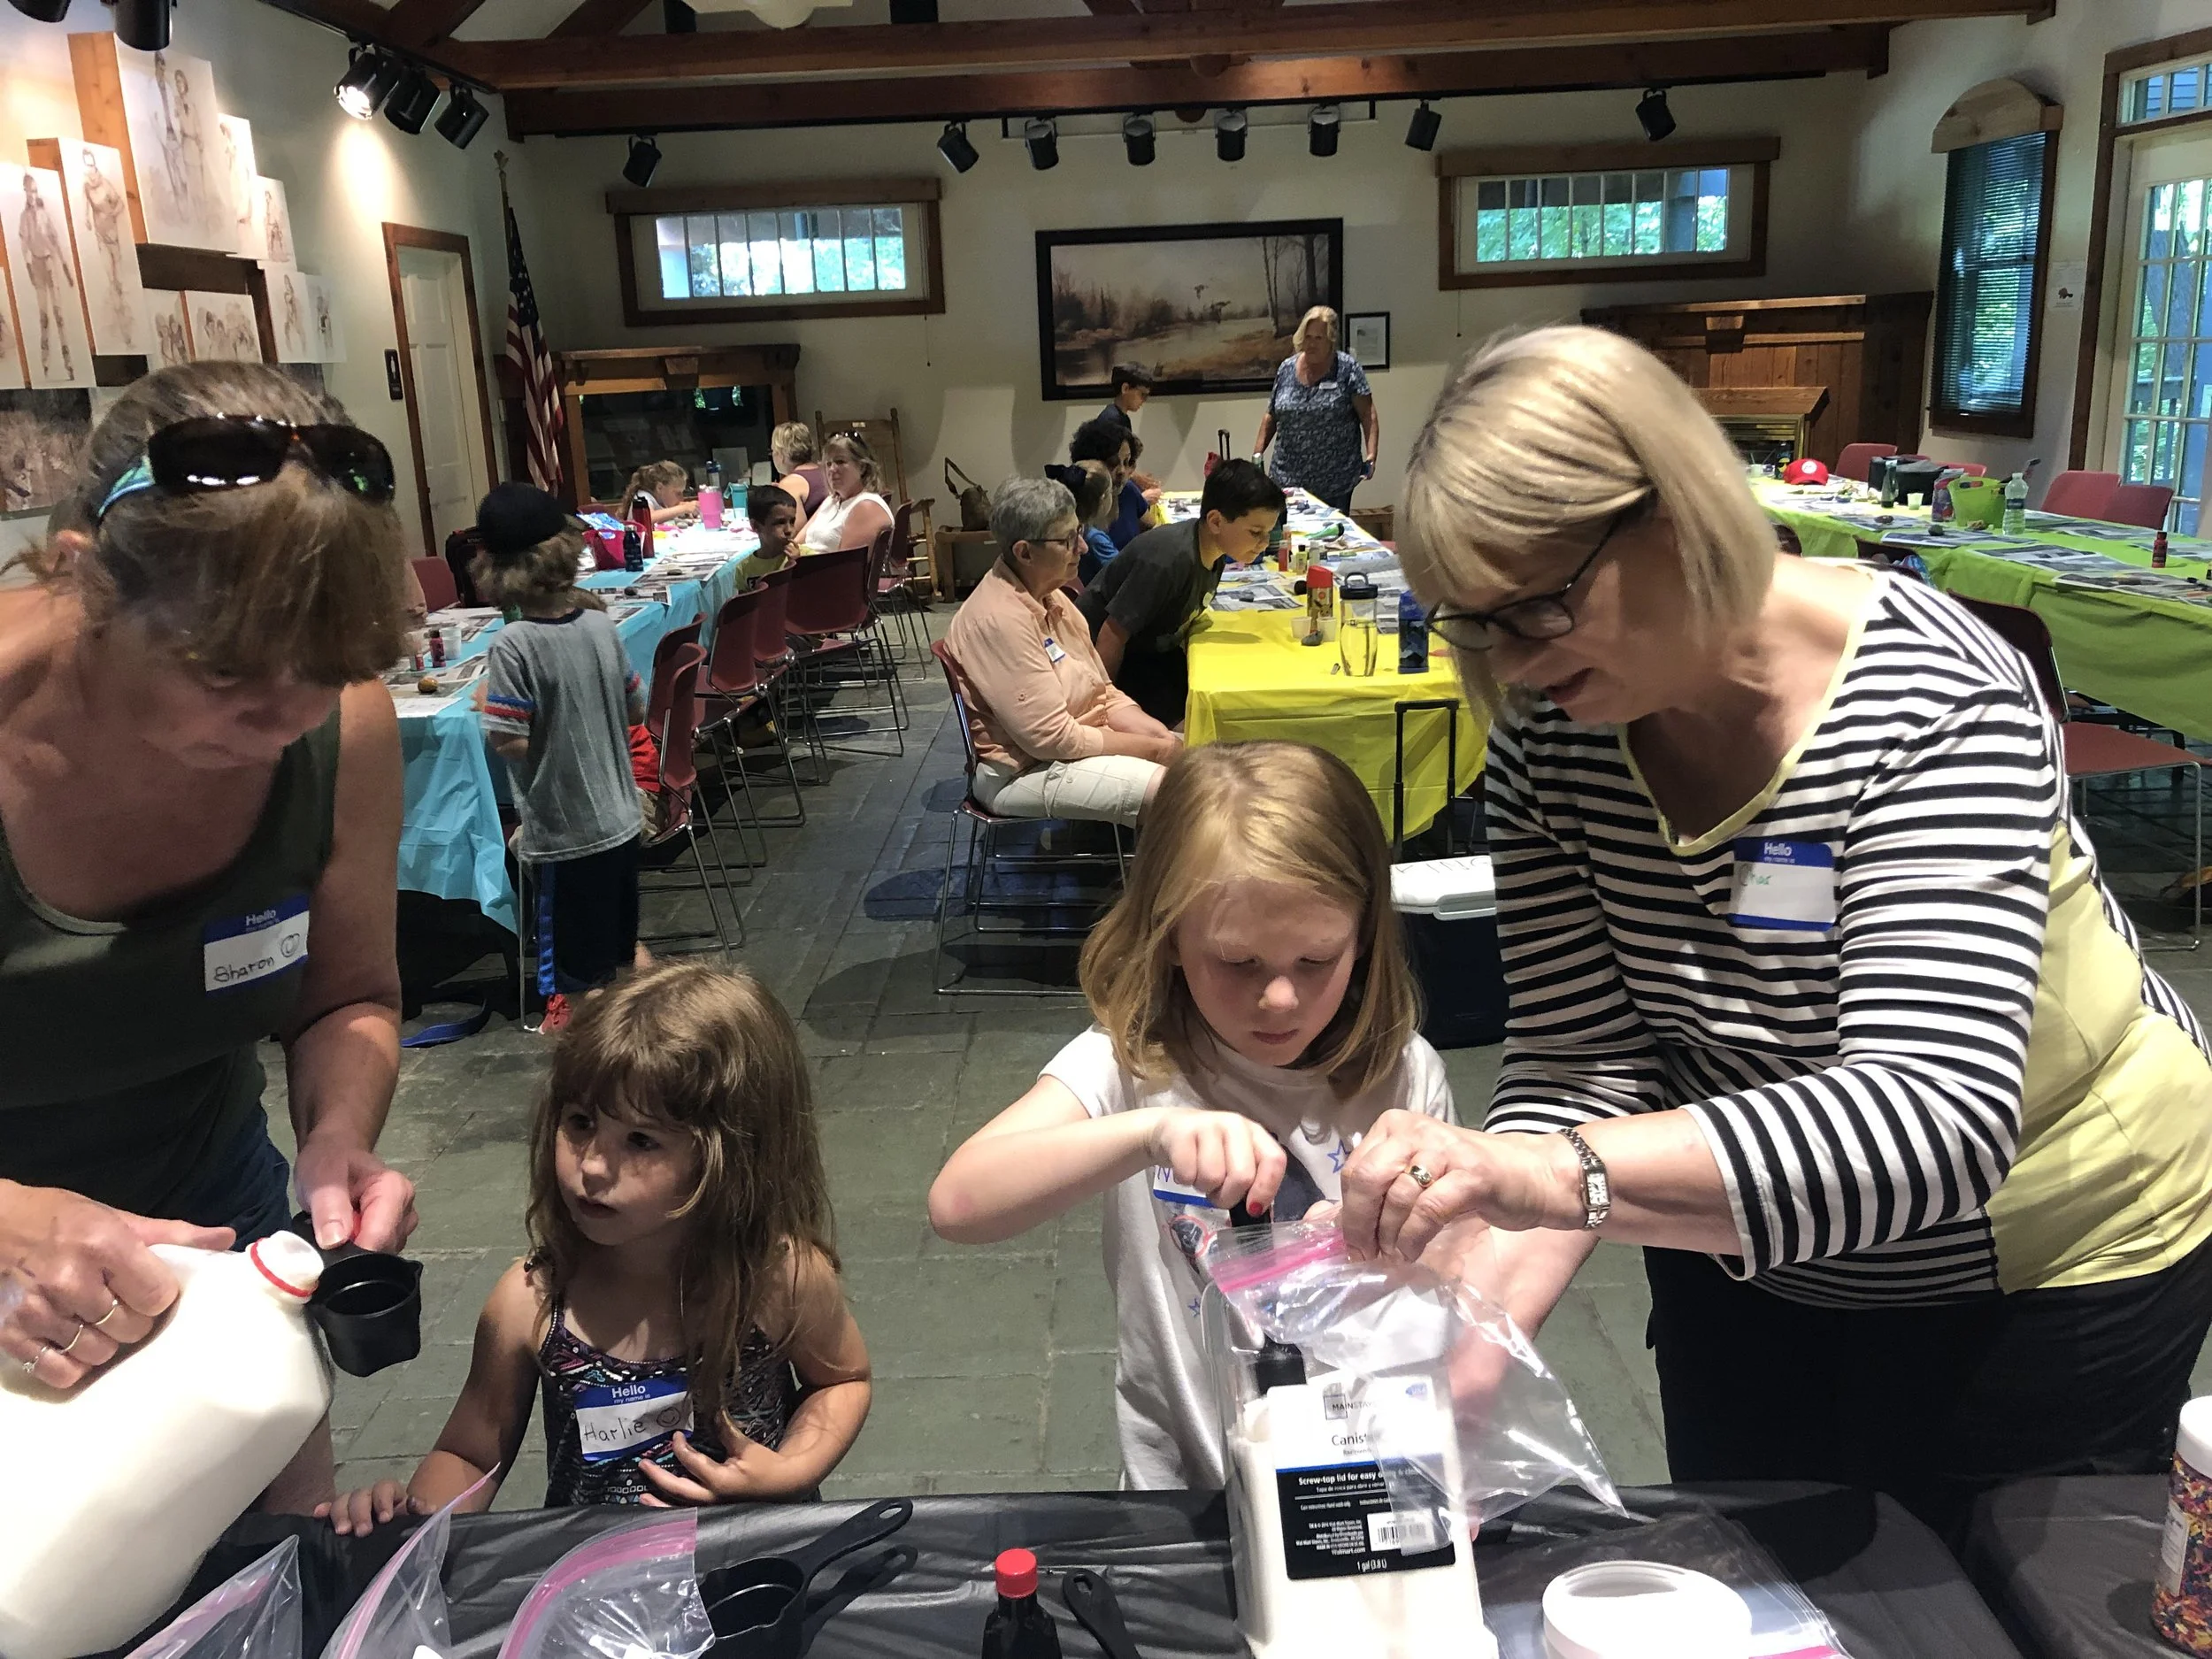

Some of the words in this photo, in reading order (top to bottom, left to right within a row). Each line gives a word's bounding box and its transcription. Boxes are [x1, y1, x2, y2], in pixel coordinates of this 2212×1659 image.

[1763, 841, 1793, 856] Hello
[245, 909, 277, 926] Hello
[213, 956, 275, 982] Sharon
[611, 1384, 646, 1399] Hello
[583, 1417, 647, 1441] Harlie
[1298, 1474, 1336, 1486] Screw-top
[1337, 1472, 1347, 1483] lid
[1348, 1471, 1359, 1481] for
[1359, 1471, 1377, 1481] easy
[1331, 1546, 1366, 1556] Walmart.com
[1356, 1561, 1361, 1571] 1
[1361, 1560, 1371, 1572] gal
